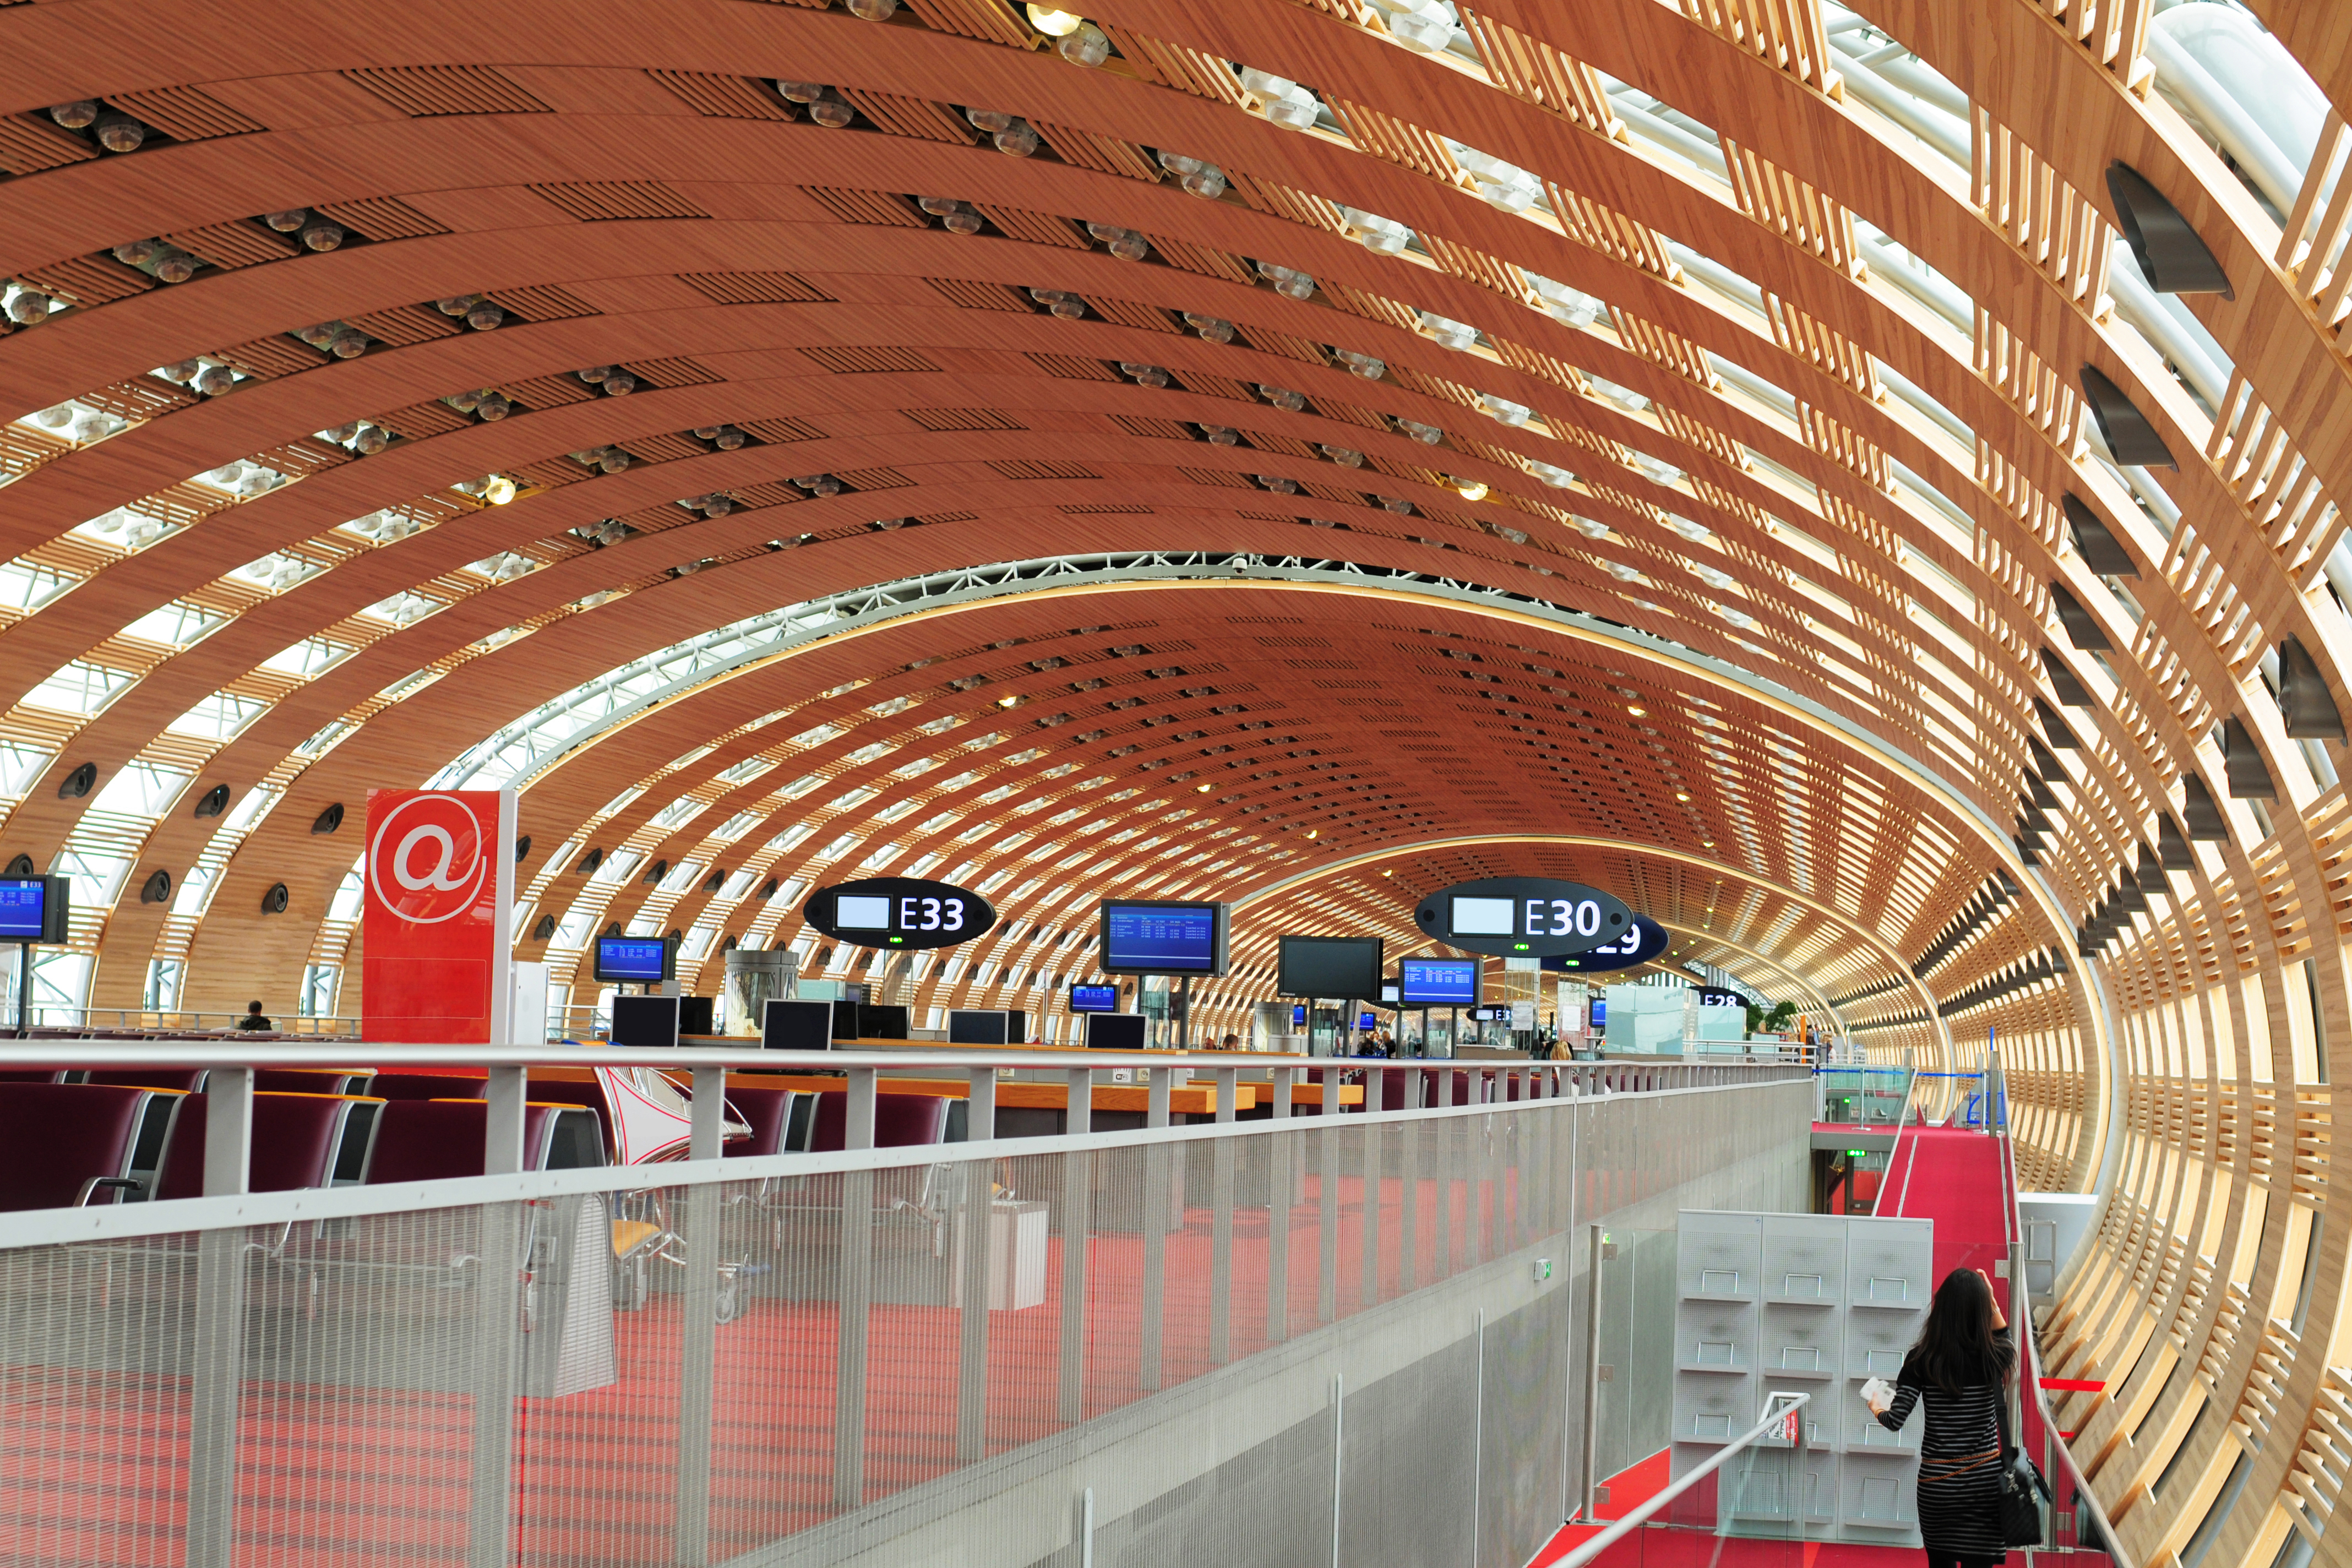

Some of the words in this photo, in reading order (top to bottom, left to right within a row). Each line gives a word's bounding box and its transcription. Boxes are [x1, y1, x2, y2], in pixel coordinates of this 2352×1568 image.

[370, 794, 487, 924] @
[901, 897, 964, 931] E33
[1526, 900, 1600, 936] E30
[1496, 1010, 1513, 1020] E3
[1705, 994, 1737, 1006] E28
